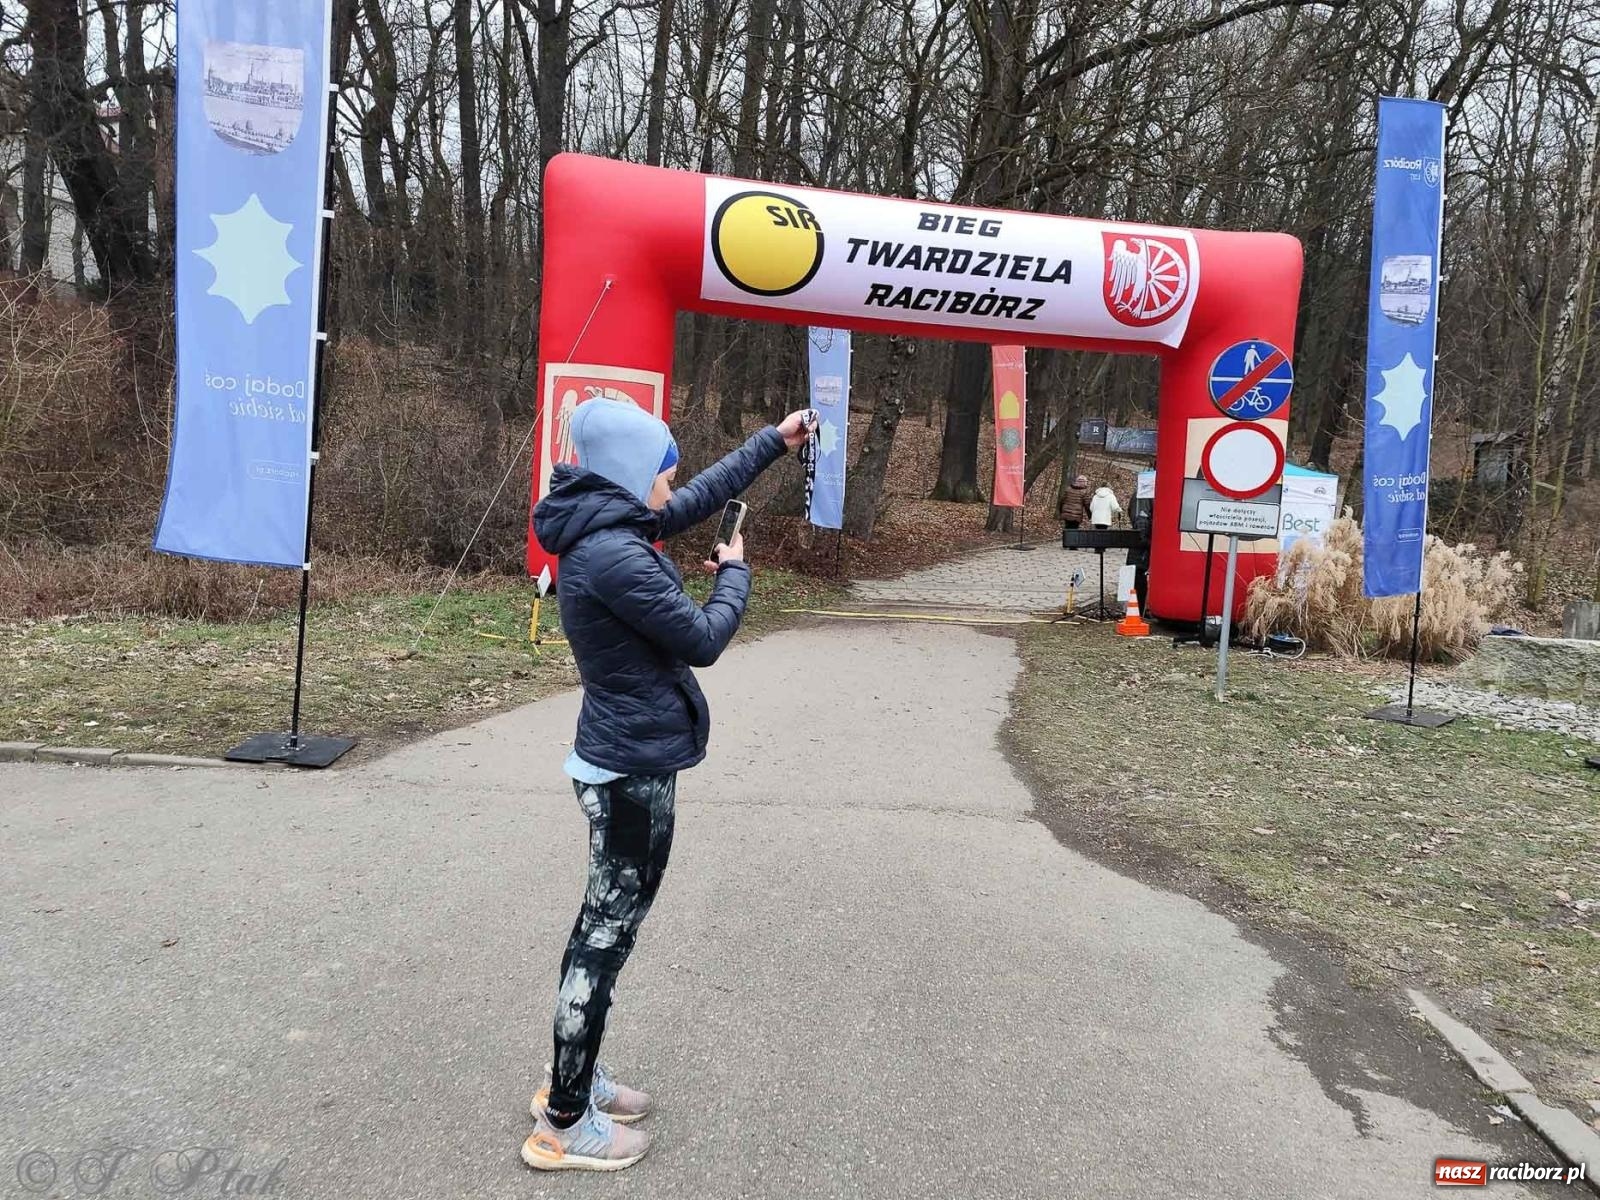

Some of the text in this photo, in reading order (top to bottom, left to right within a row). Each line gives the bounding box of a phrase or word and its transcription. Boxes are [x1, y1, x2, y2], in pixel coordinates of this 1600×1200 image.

[917, 212, 1003, 237] BIEG
[846, 238, 1072, 285] TWARDZIELA
[864, 283, 1046, 320] RACIBÓRZ
[1282, 513, 1321, 533] Best
